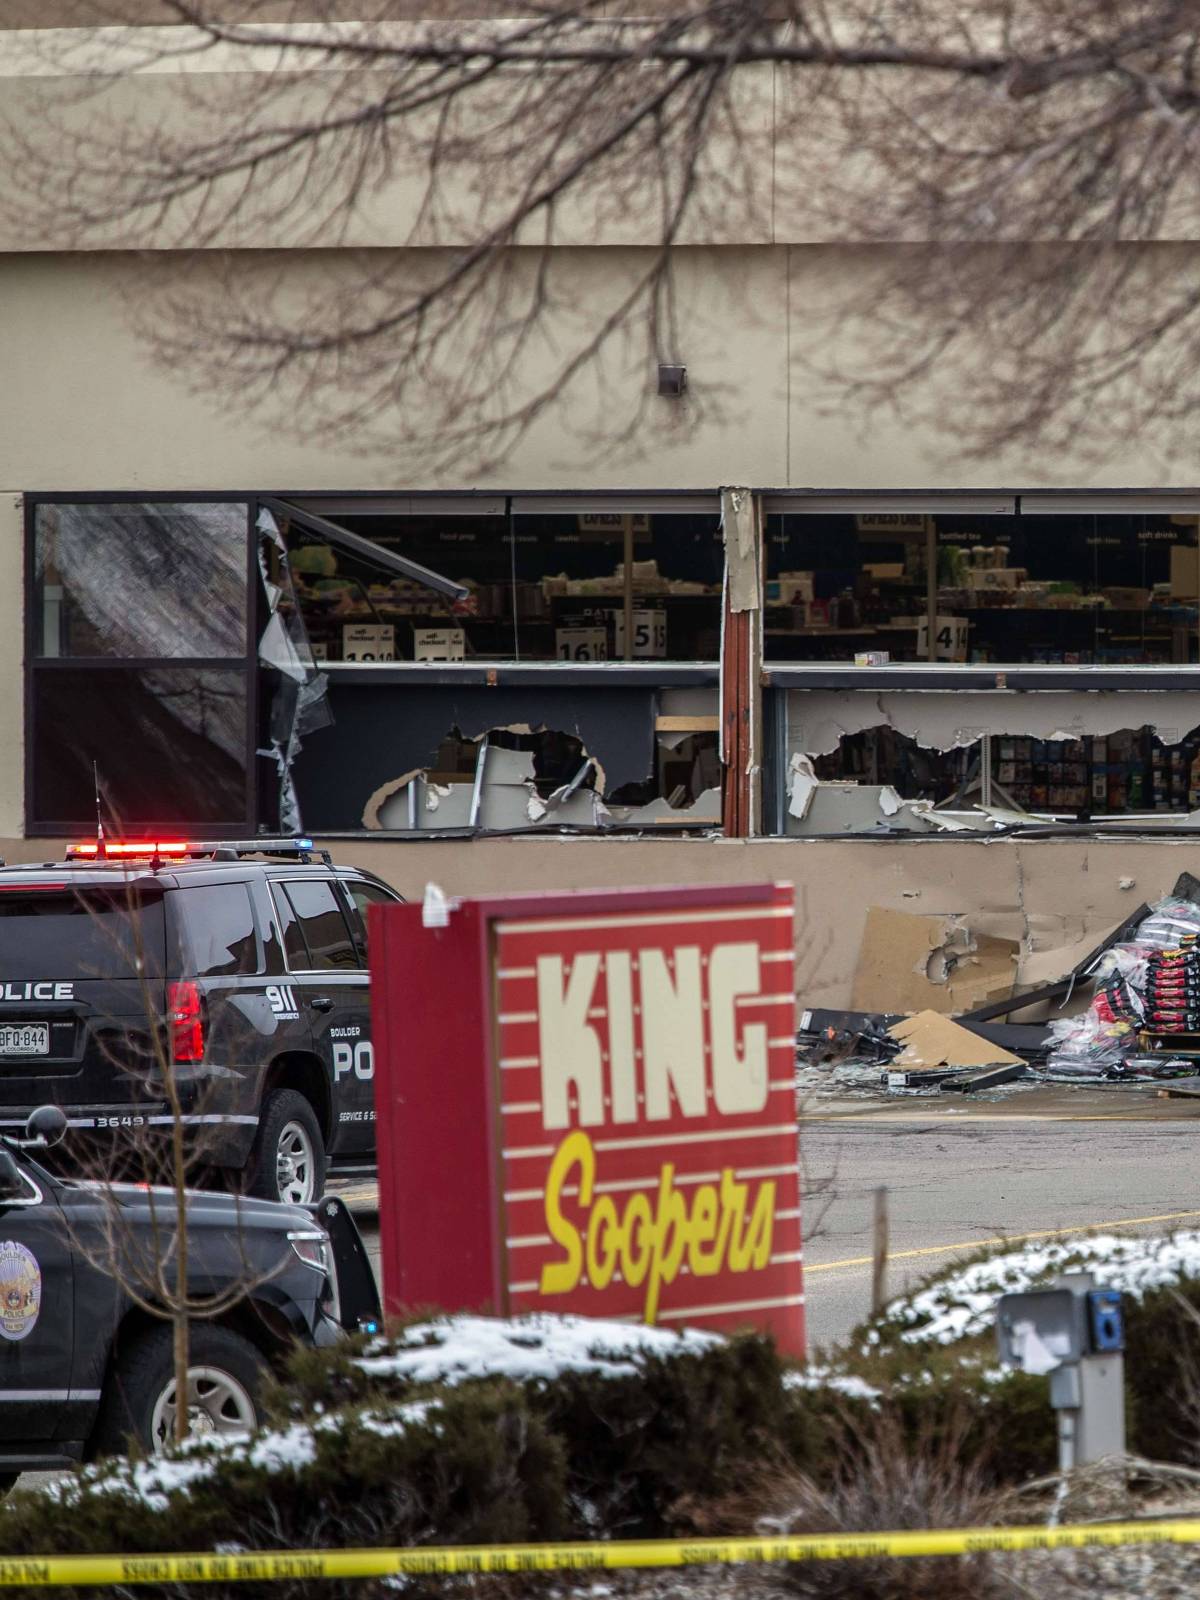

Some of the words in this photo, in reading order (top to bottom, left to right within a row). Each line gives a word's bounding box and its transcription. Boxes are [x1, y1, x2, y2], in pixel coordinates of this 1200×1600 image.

[921, 626, 953, 648] 14
[559, 643, 590, 661] 16
[266, 985, 298, 1012] 911
[330, 1027, 361, 1038] BOULDER
[537, 941, 769, 1130] KING
[96, 1116, 145, 1127] 3649
[338, 1112, 362, 1121] SERVICE
[538, 1130, 777, 1326] Soopers
[121, 1561, 169, 1581] CROSS
[176, 1561, 204, 1580] NOT
[209, 1561, 229, 1580] DO
[235, 1560, 266, 1579] LINE
[273, 1559, 324, 1578] POLICE
